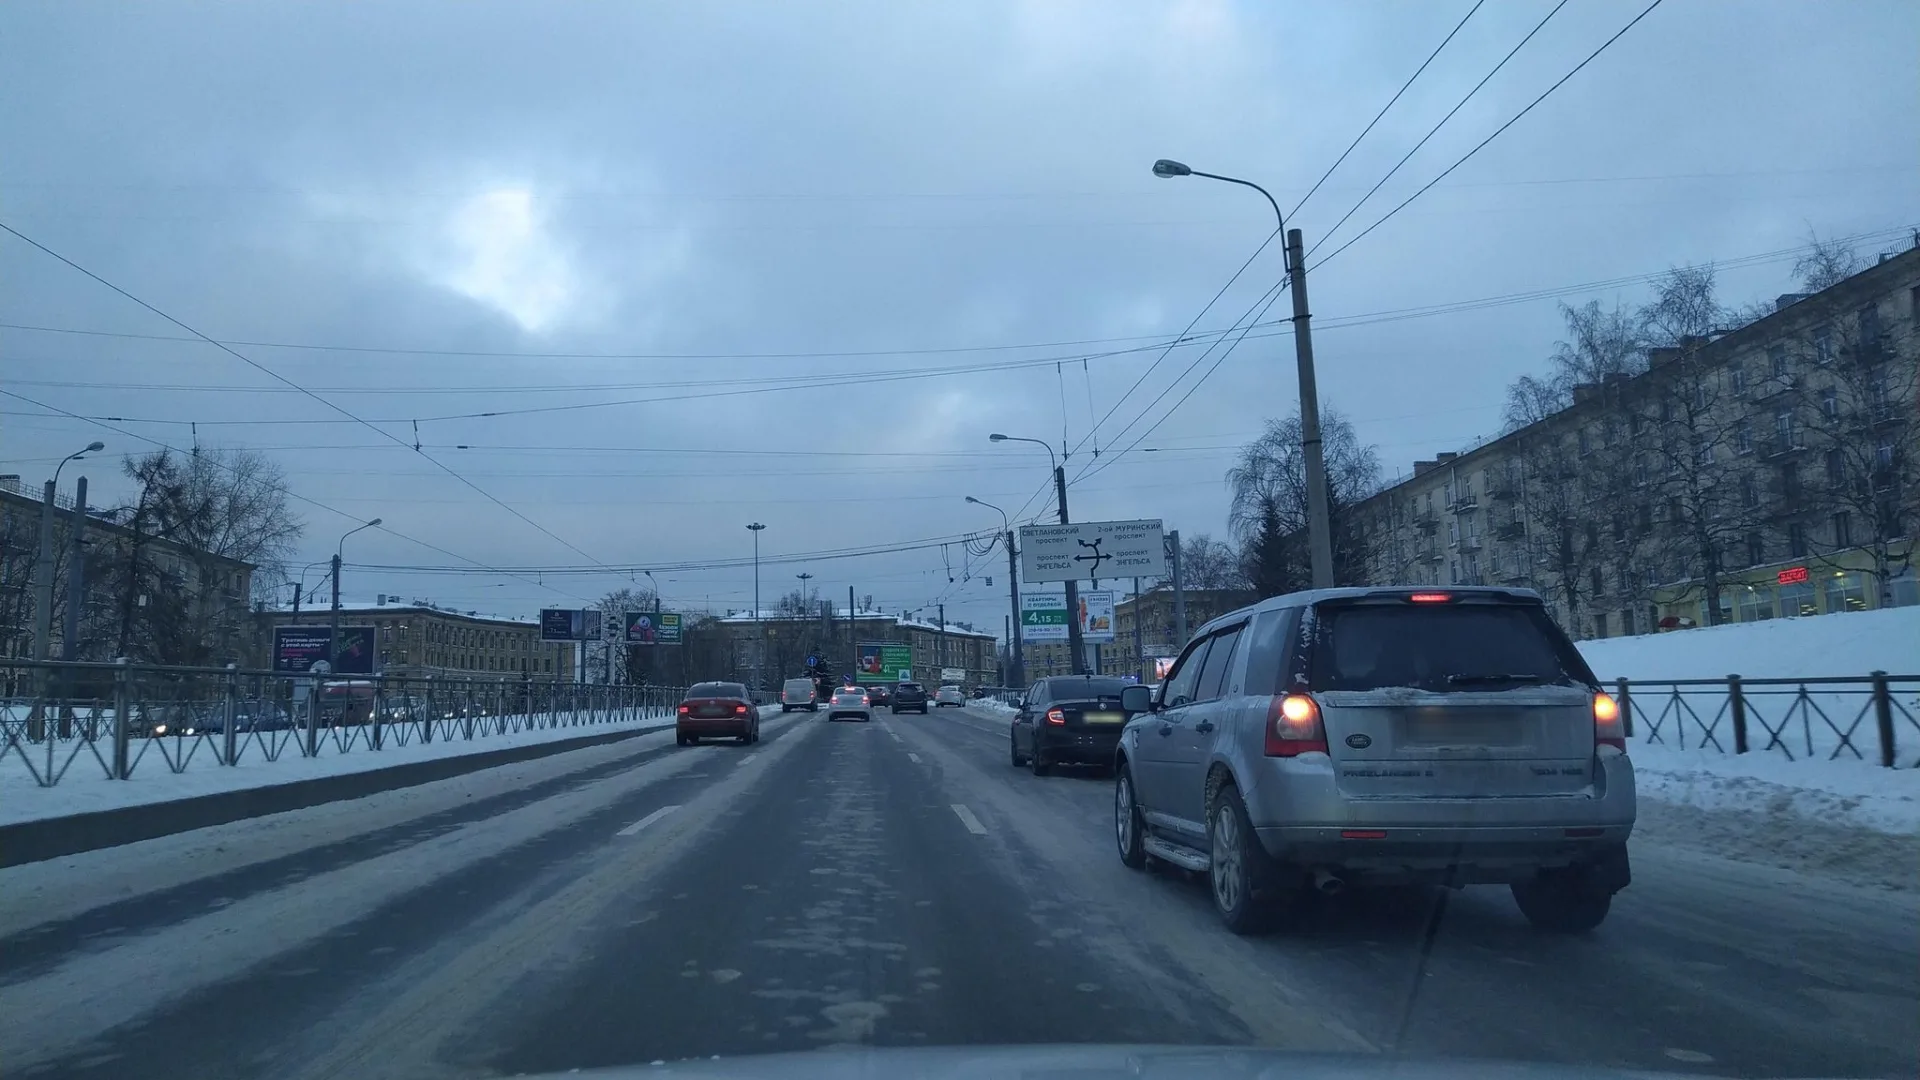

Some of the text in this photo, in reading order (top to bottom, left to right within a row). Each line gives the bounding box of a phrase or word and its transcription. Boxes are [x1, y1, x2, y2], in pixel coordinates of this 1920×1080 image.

[1022, 527, 1080, 537] СВЕТЛАНОВСКИЙ
[1115, 523, 1162, 532] МУРИНСКИЙ
[1035, 537, 1067, 545] проспект
[1114, 532, 1146, 541] проспект
[1036, 553, 1069, 562] проспект
[1116, 550, 1148, 558] проспект
[1036, 561, 1071, 570] ЭНГЕЛЬСА
[1116, 558, 1151, 566] ЭНГЕЛЬСА
